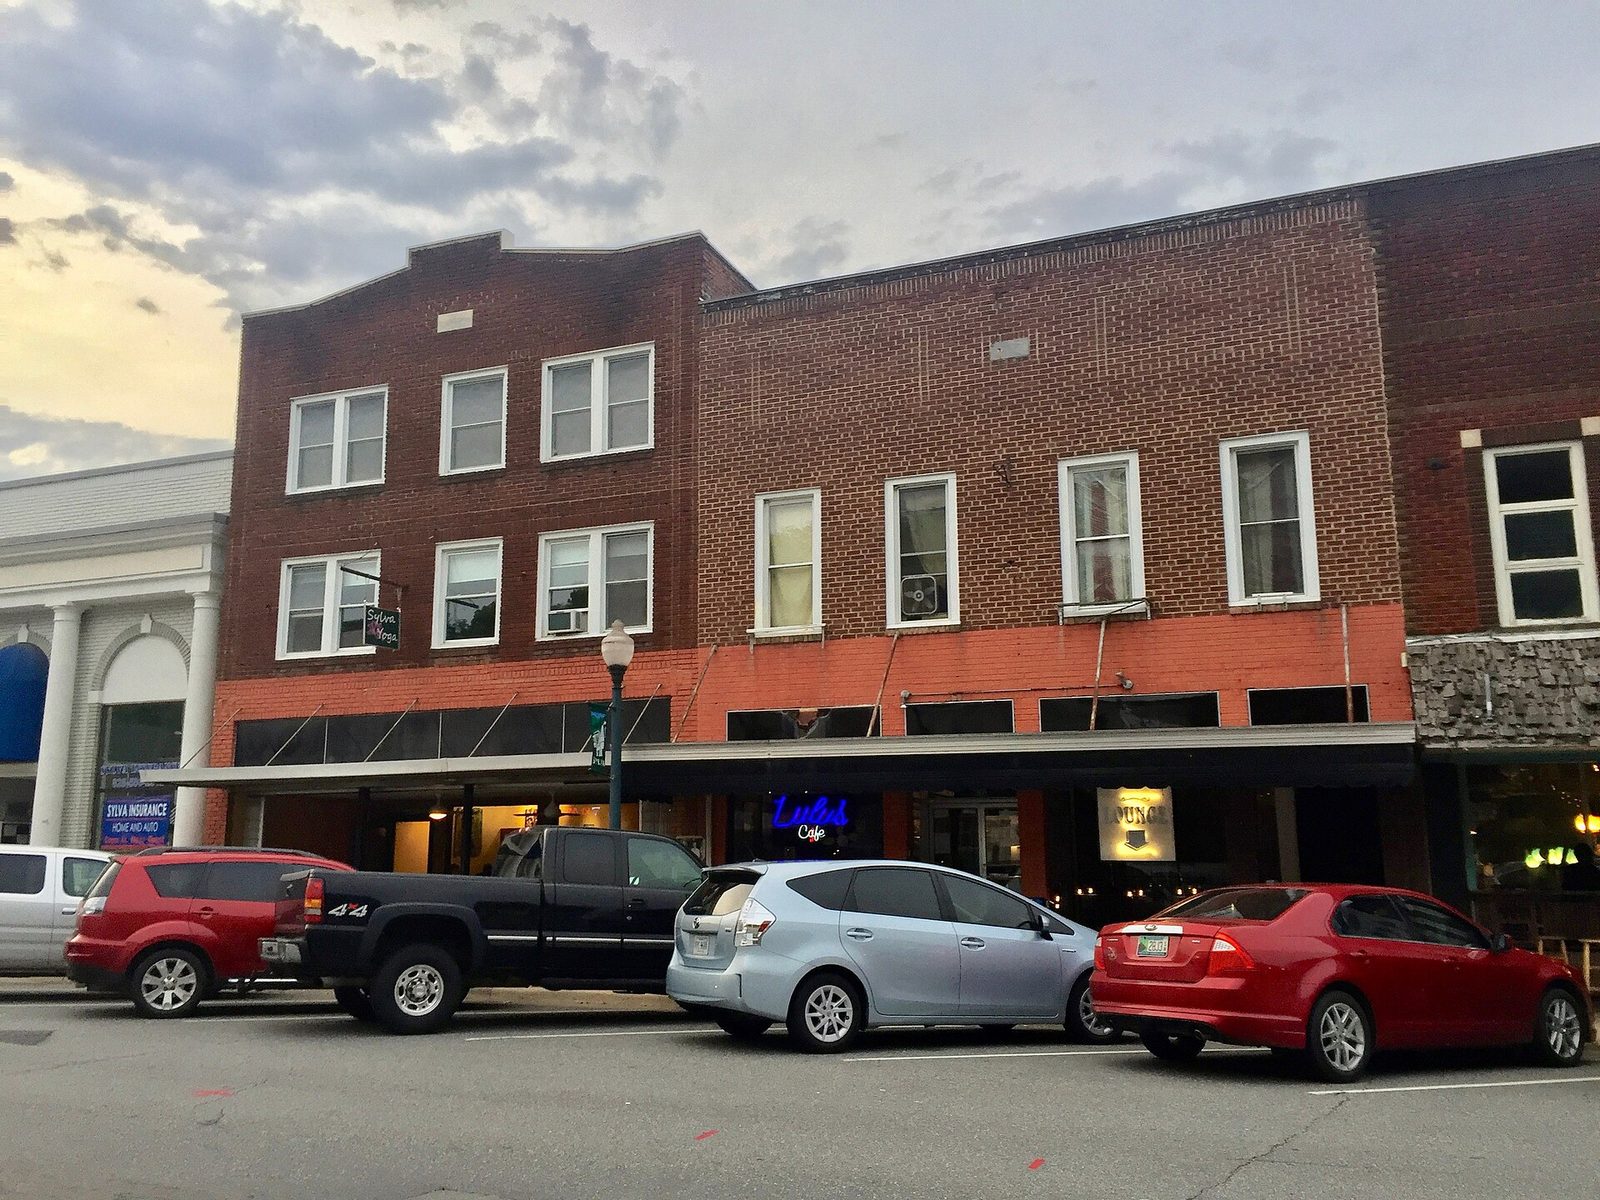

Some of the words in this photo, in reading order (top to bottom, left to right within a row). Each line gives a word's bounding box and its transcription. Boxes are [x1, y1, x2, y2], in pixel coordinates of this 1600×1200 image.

[367, 609, 396, 624] Sylva
[376, 627, 398, 644] Yoga
[107, 804, 128, 818] SYLVA
[129, 803, 168, 817] INSURANCE
[112, 823, 130, 833] HOME
[130, 822, 143, 833] AND
[143, 821, 159, 833] AUTO
[798, 824, 826, 842] Cafe
